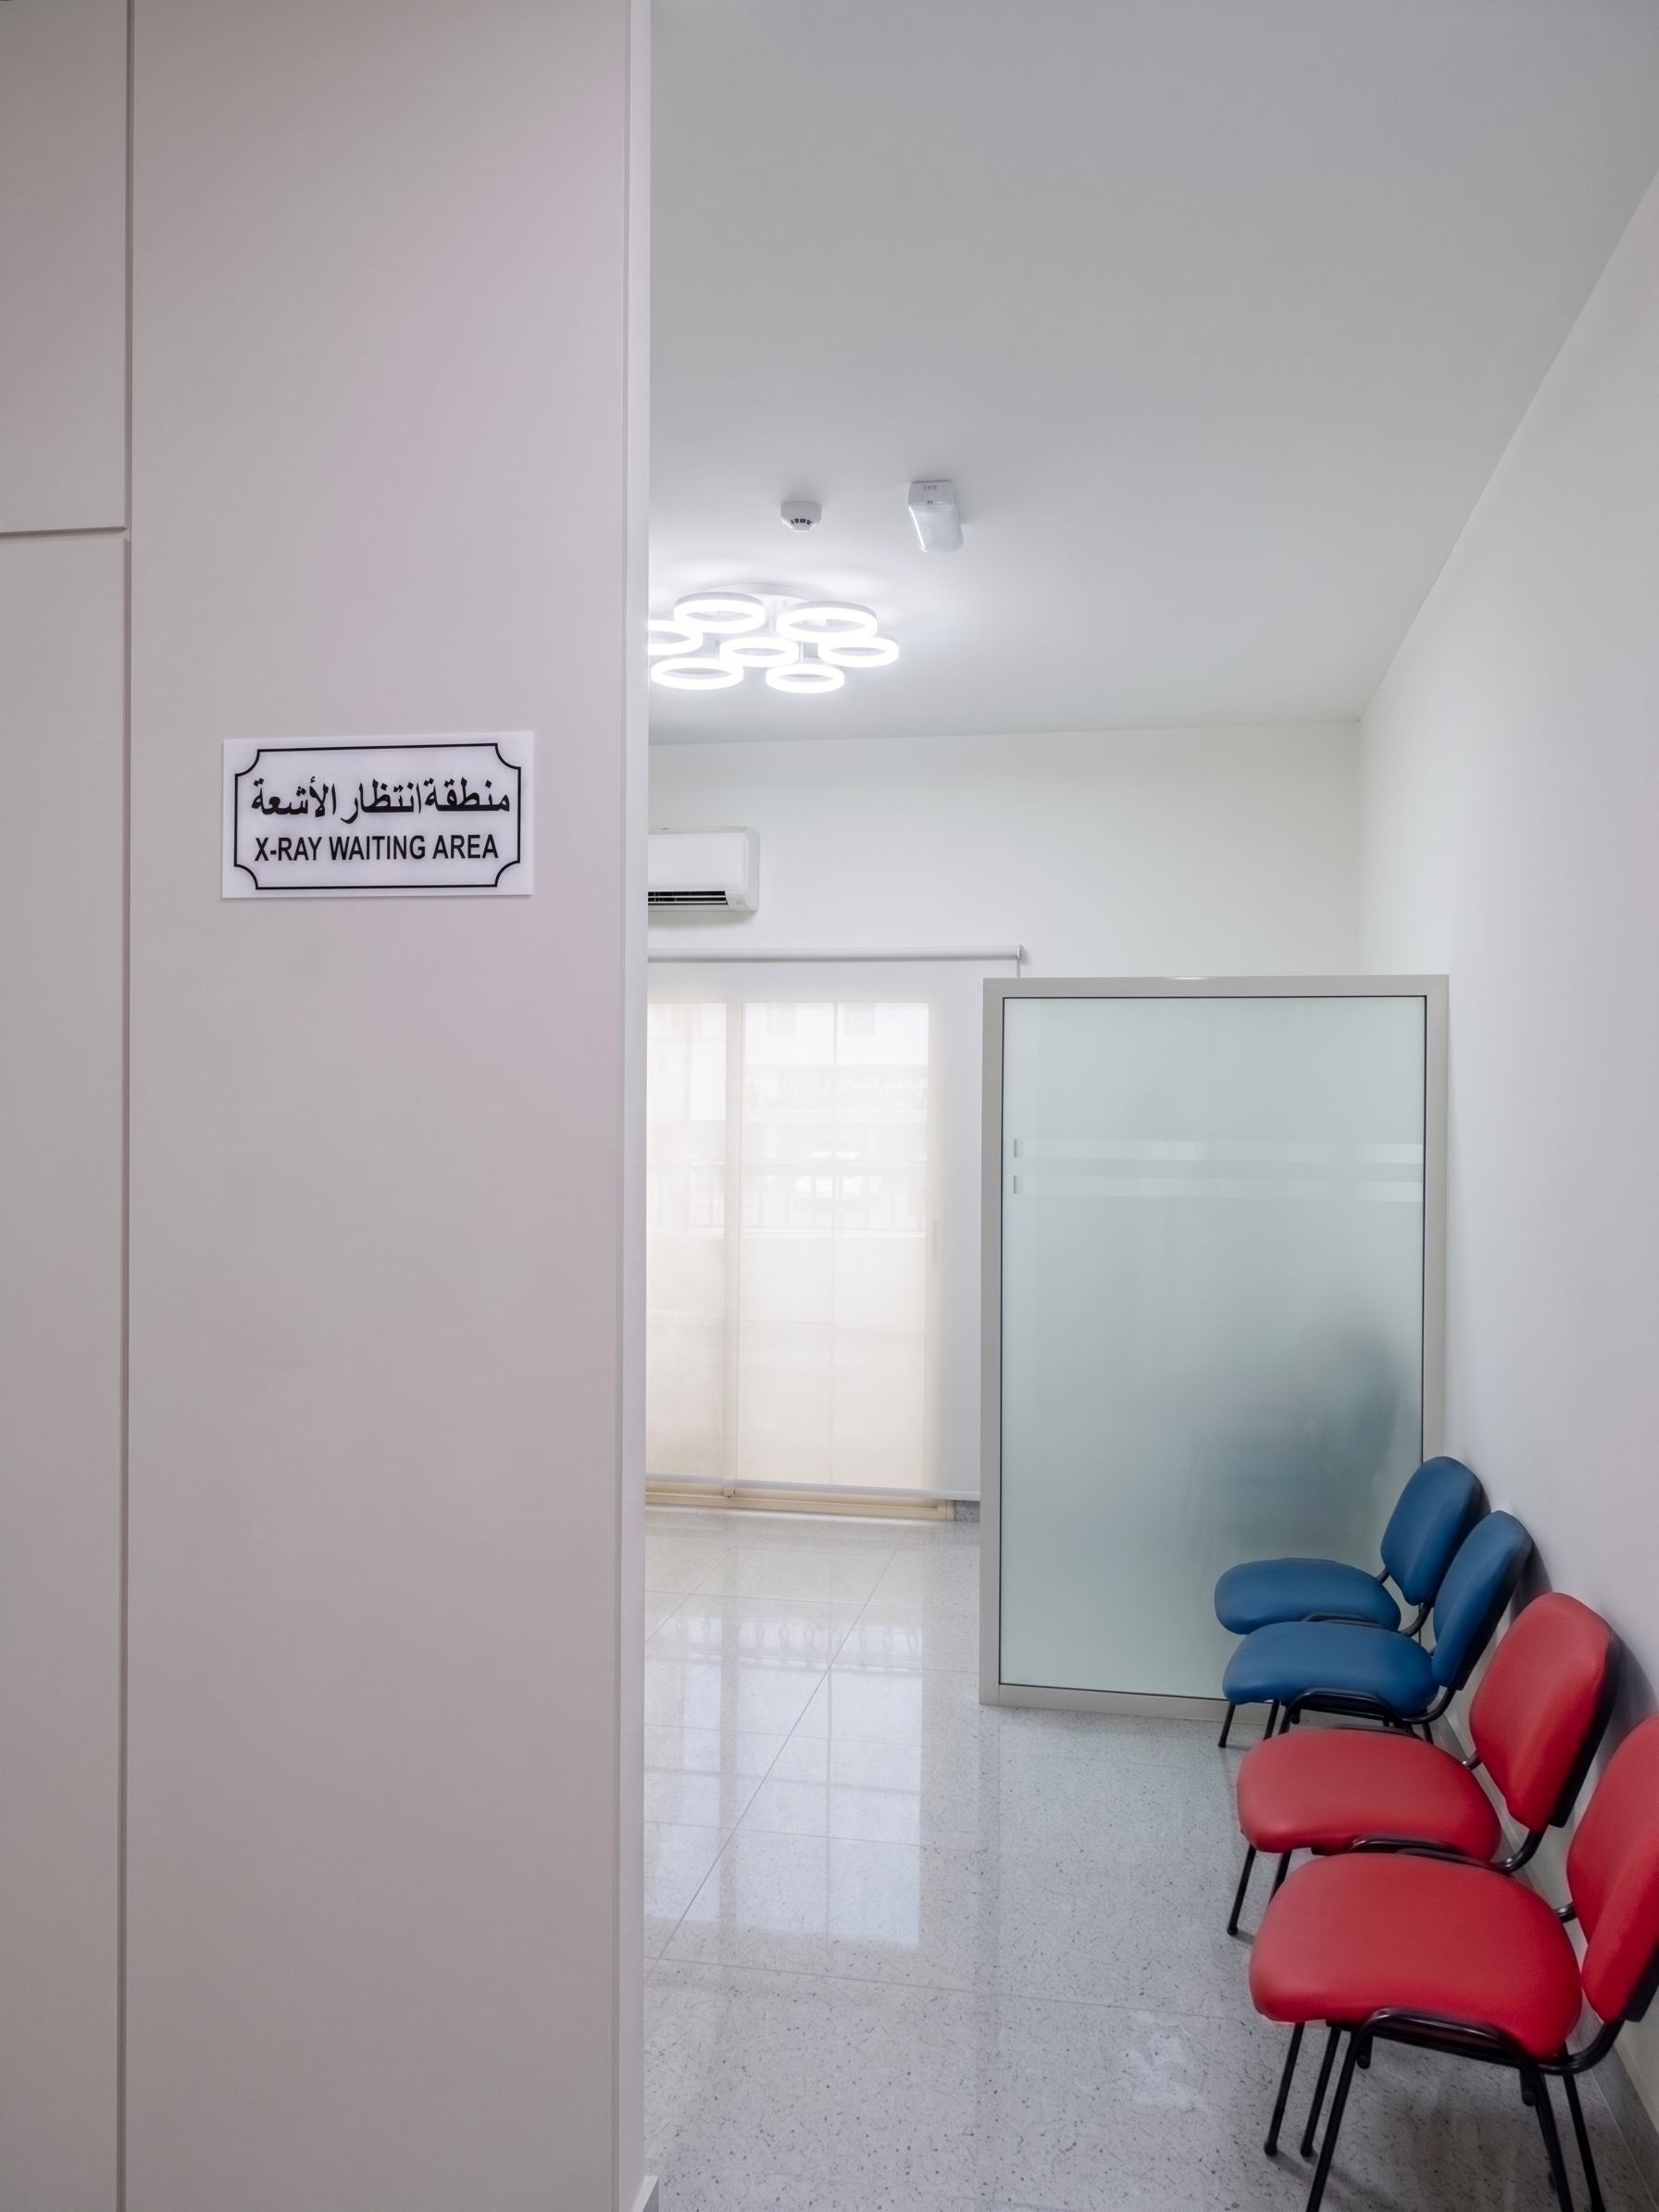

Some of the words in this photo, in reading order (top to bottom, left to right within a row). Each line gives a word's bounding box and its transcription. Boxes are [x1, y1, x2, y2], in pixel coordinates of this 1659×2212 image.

[251, 776, 337, 818] الأشعة
[341, 778, 422, 825] انتظار
[424, 777, 510, 813] منطقة
[254, 836, 323, 862] X-RAY
[329, 835, 426, 861] WAITING
[432, 834, 499, 860] AREA
